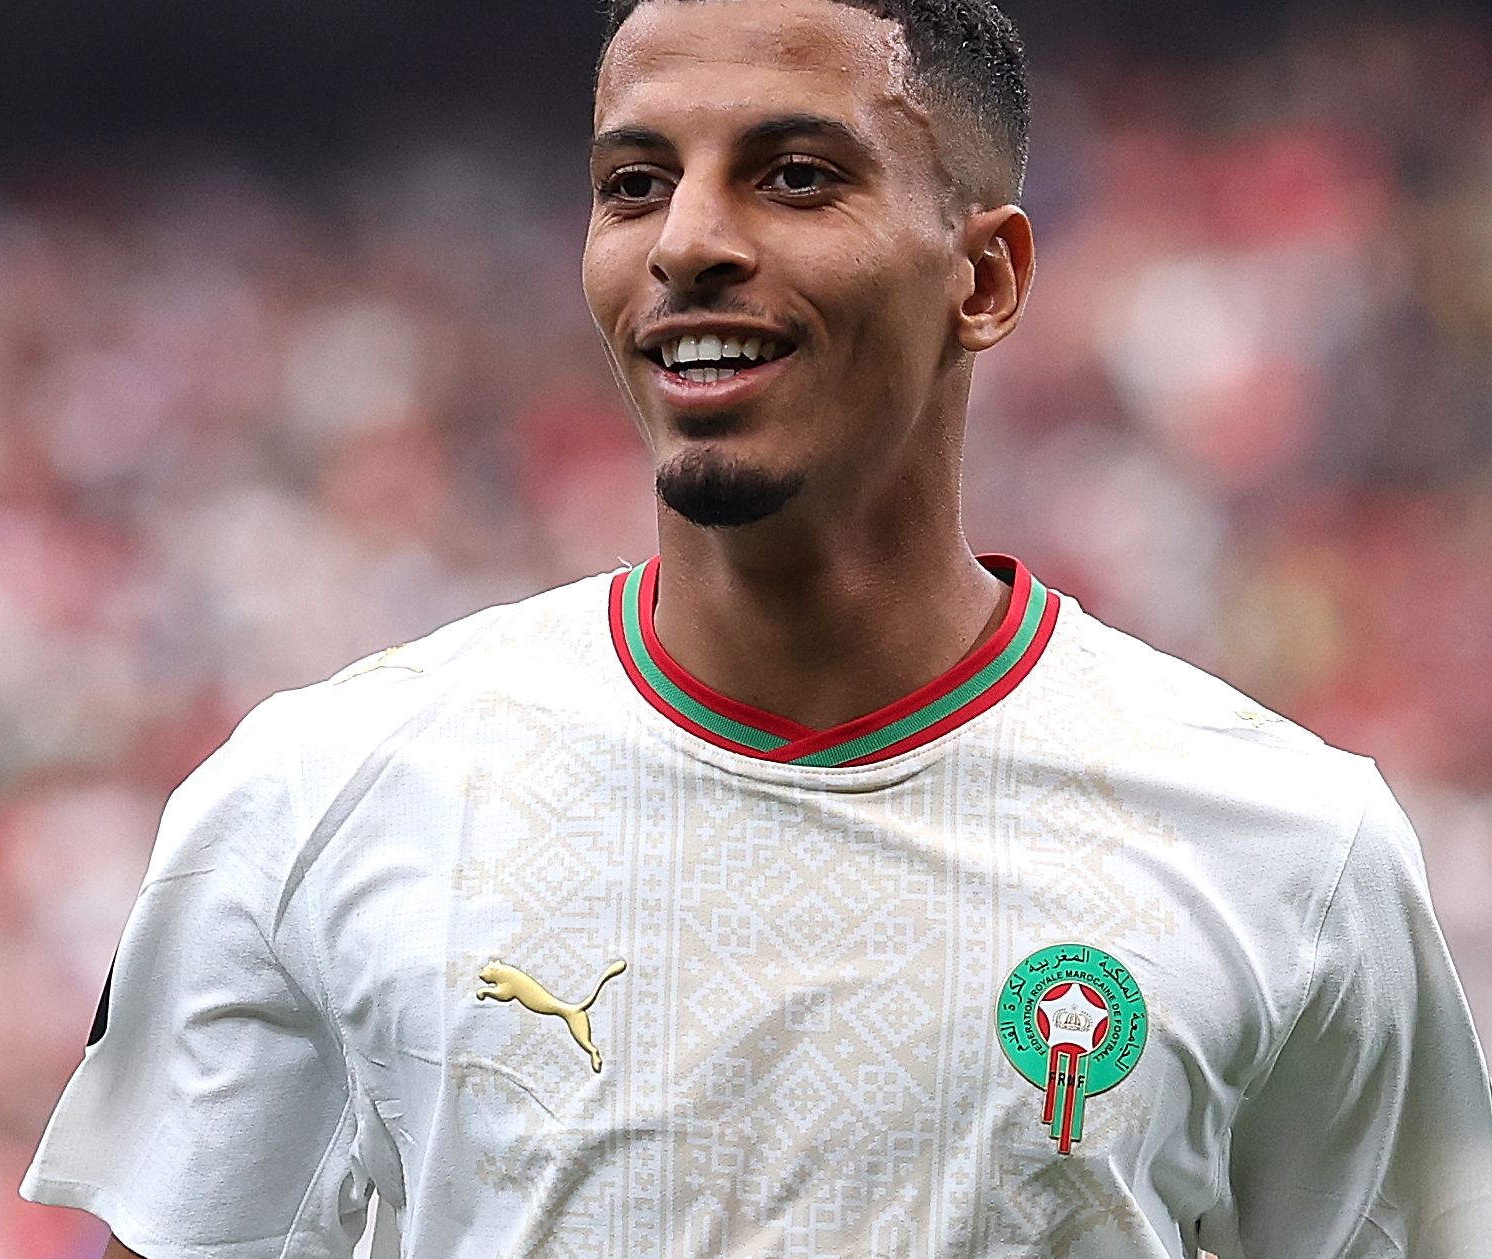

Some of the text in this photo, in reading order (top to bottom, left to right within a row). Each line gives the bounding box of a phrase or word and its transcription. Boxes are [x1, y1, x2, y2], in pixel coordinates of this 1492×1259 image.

[1001, 948, 1145, 1072] الجامعة الملكية المغربية لكرة القدم
[1024, 970, 1122, 1062] FEDERATION ROYALE MAROCAINE DE FOOTBALL
